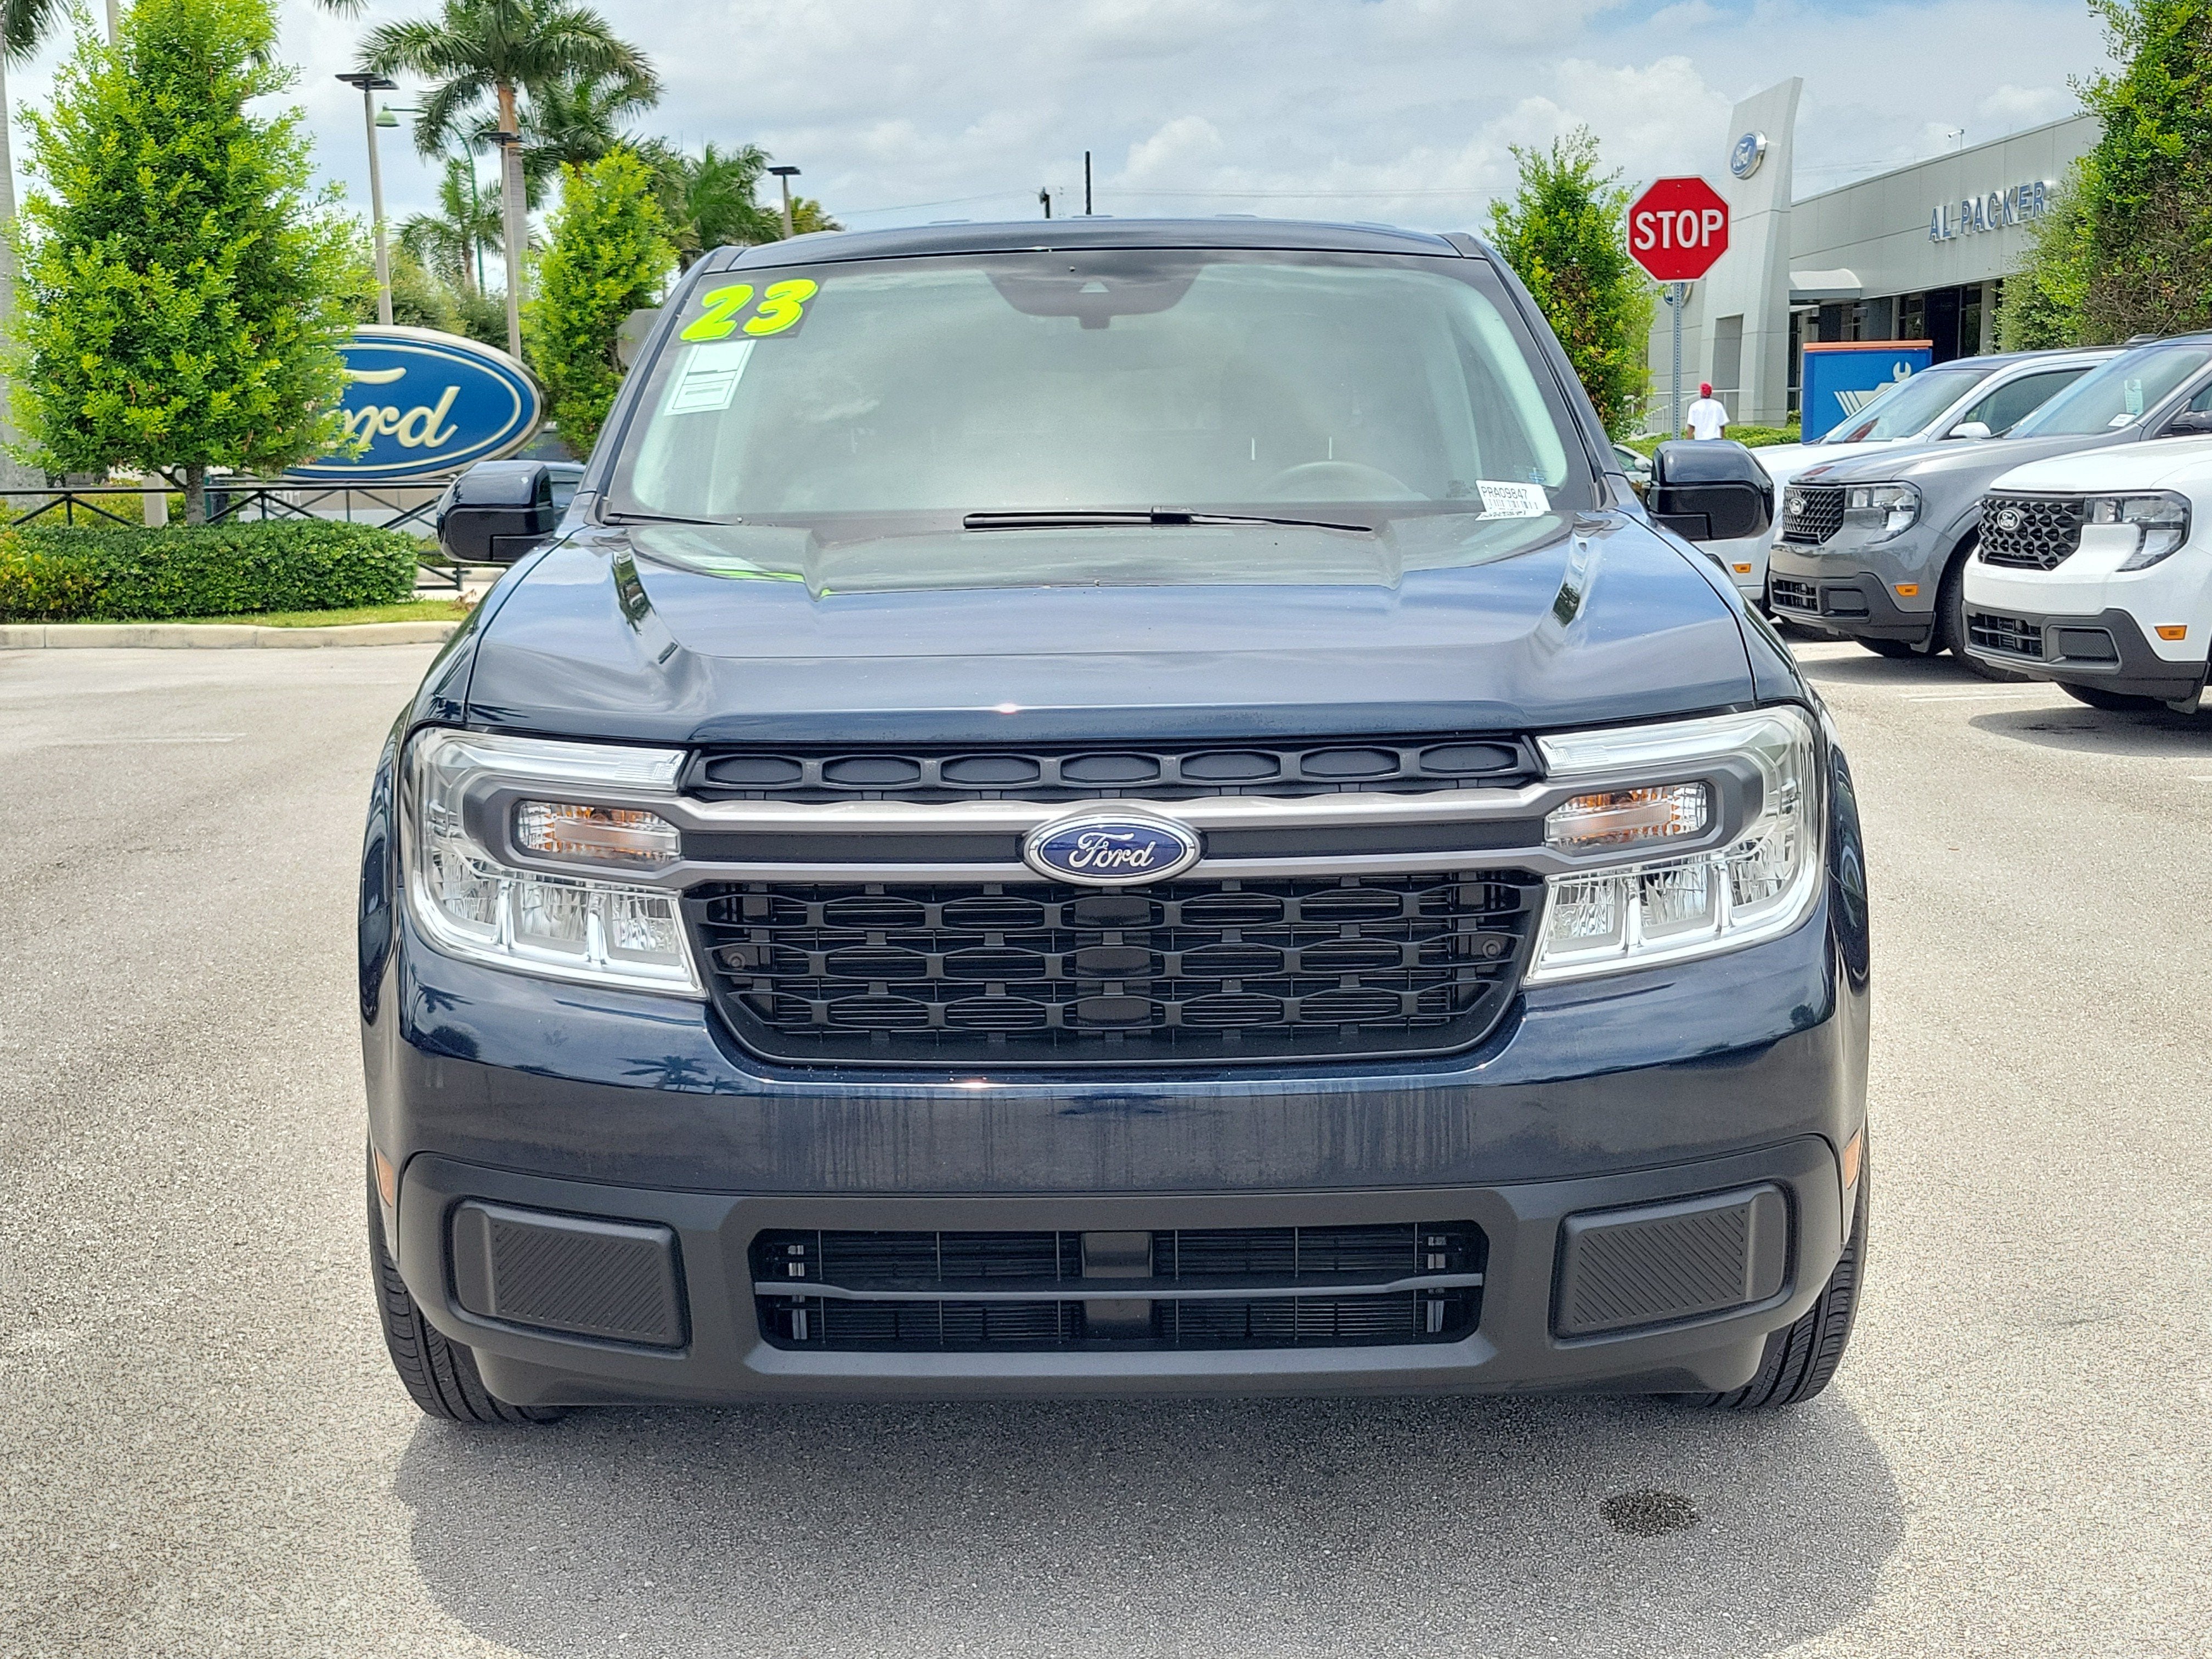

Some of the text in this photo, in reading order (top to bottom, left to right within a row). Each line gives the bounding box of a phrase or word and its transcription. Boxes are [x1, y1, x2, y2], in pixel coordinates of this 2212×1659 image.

[1634, 209, 1724, 250] STOP
[1928, 180, 2045, 242] AL PACKER
[679, 279, 819, 340] 23
[336, 366, 461, 448] rd
[1069, 832, 1155, 868] Ford
